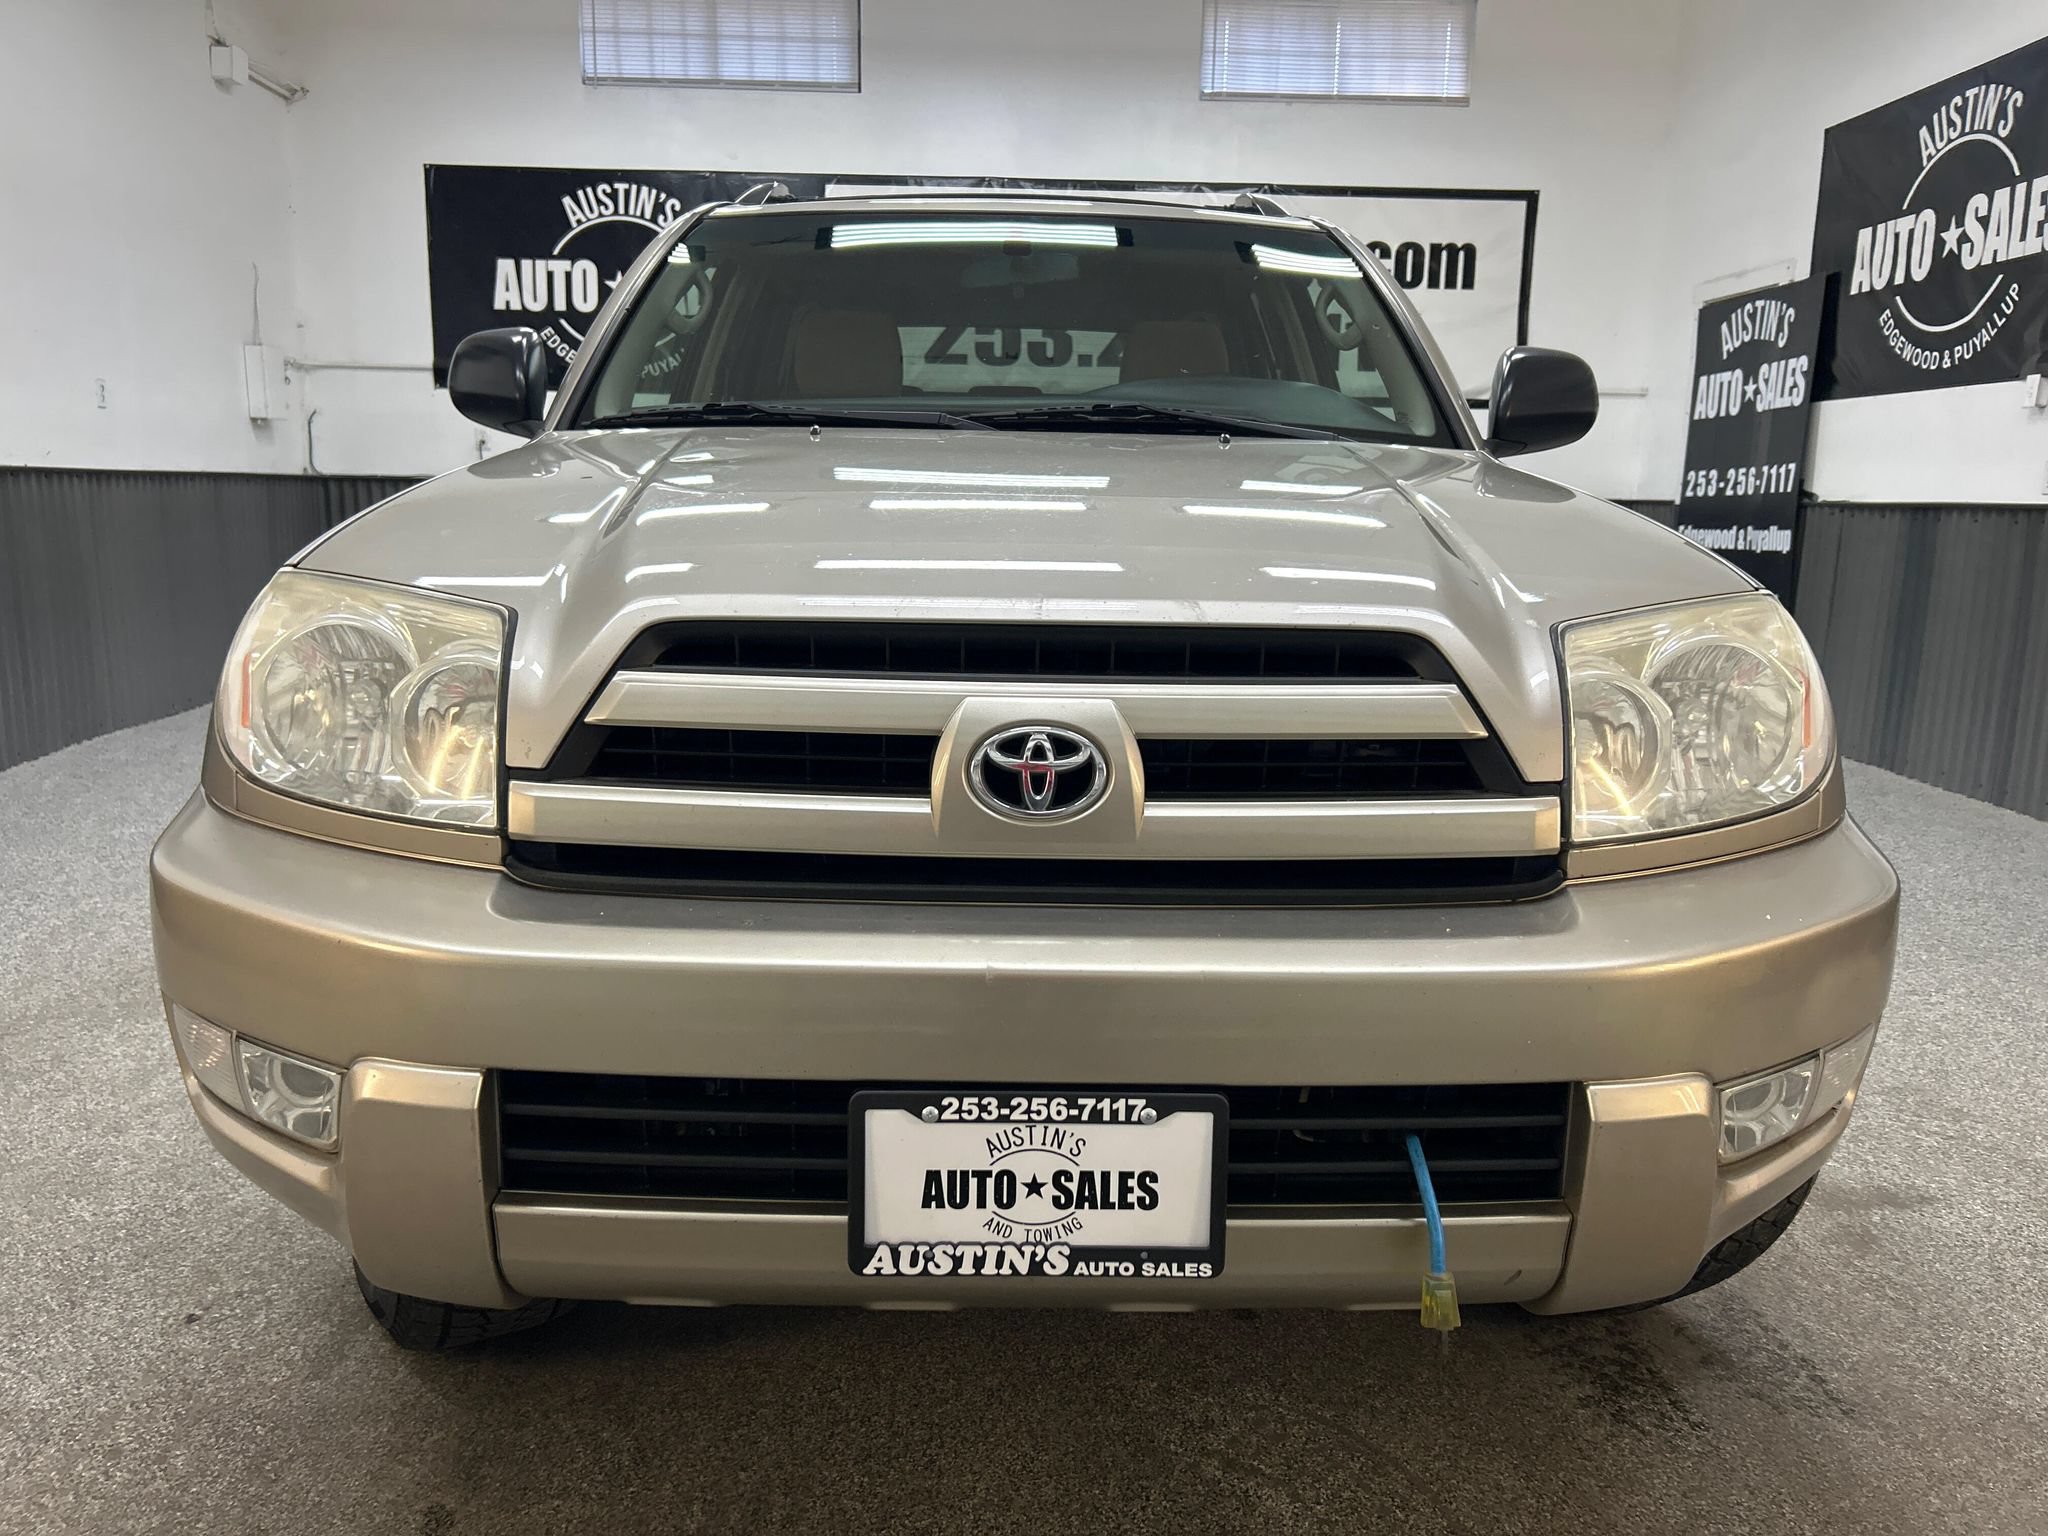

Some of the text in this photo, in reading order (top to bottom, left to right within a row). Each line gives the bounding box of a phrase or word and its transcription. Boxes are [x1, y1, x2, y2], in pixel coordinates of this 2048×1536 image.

[1918, 84, 2024, 167] AUSTIN'S
[560, 182, 682, 229] AUSTIN'S
[1850, 208, 1937, 296] AUTO
[493, 258, 600, 314] AUTO
[540, 326, 578, 364] EDGE
[1720, 299, 1796, 360] AUSTIN'S
[1879, 282, 2022, 371] EDGEWOOD & PUYALLUP
[1693, 355, 1809, 421] AUTO SALES
[1685, 462, 1796, 498] 253-256-7117
[1737, 529, 1745, 550] &
[1746, 525, 1792, 554] Puyallup
[941, 1097, 1147, 1122] 253-256-7117
[985, 1124, 1087, 1159] AUSTIN'S
[921, 1169, 1159, 1211] AUTO SALES
[982, 1217, 1084, 1243] AND TOWING
[863, 1243, 1213, 1277] AUSTIN'S AUTO SALES
